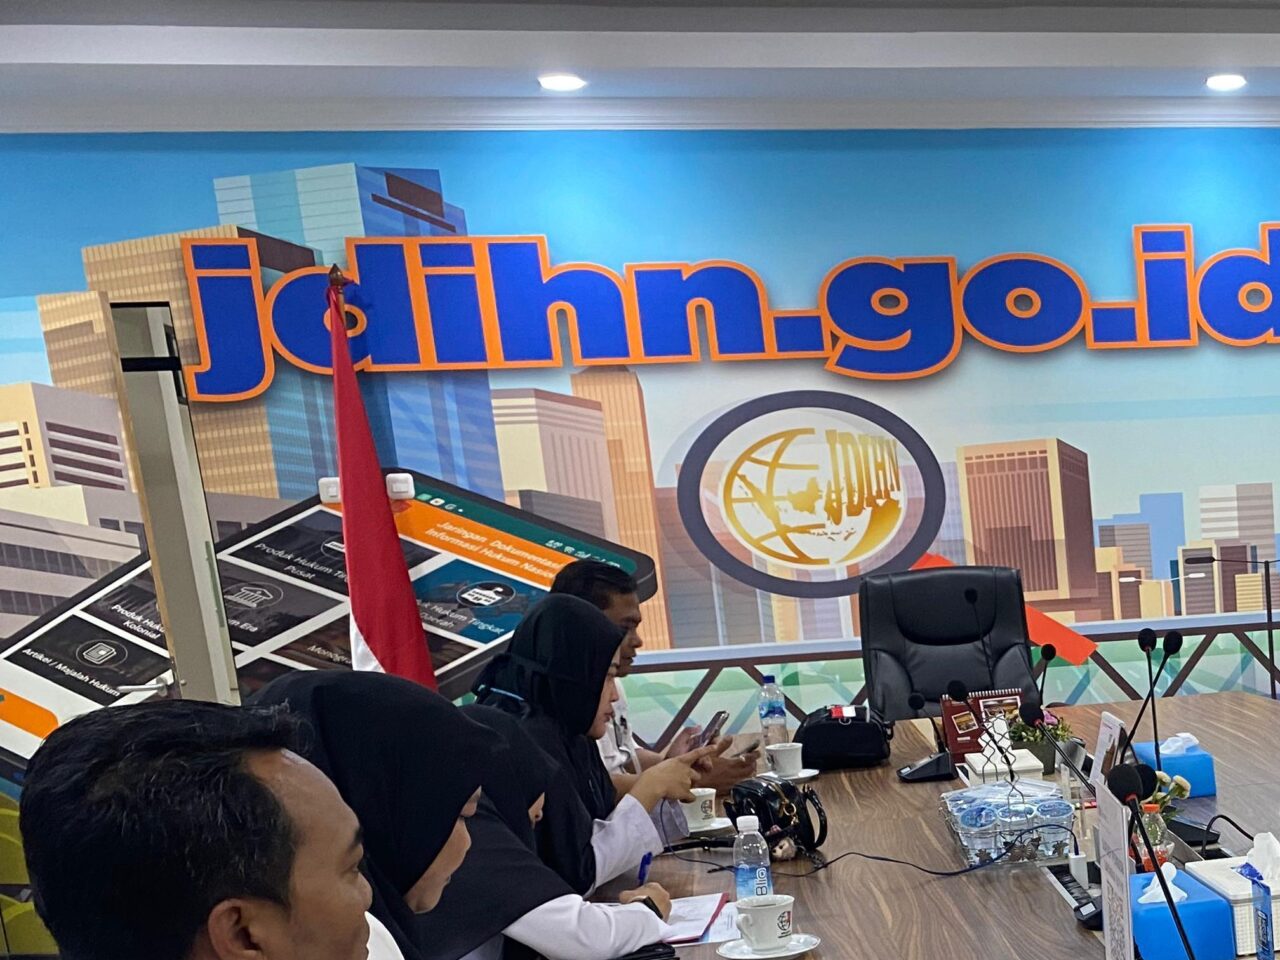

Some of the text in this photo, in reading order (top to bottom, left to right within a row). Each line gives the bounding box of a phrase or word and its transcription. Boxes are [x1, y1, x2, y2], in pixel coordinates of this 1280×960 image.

[425, 528, 480, 552] Informasi
[480, 547, 520, 567] Hukum
[437, 521, 487, 544] Jaringan
[254, 543, 294, 560] Produk
[294, 556, 333, 574] Hukum
[284, 564, 316, 579] Pusat
[111, 604, 165, 633] Produk Huku
[123, 619, 161, 640] Kolonial
[431, 601, 468, 621] Hukum
[468, 617, 505, 634] Tingkat
[22, 648, 52, 666] Artikel
[56, 662, 90, 683] Majalah
[89, 678, 121, 698] Hukum
